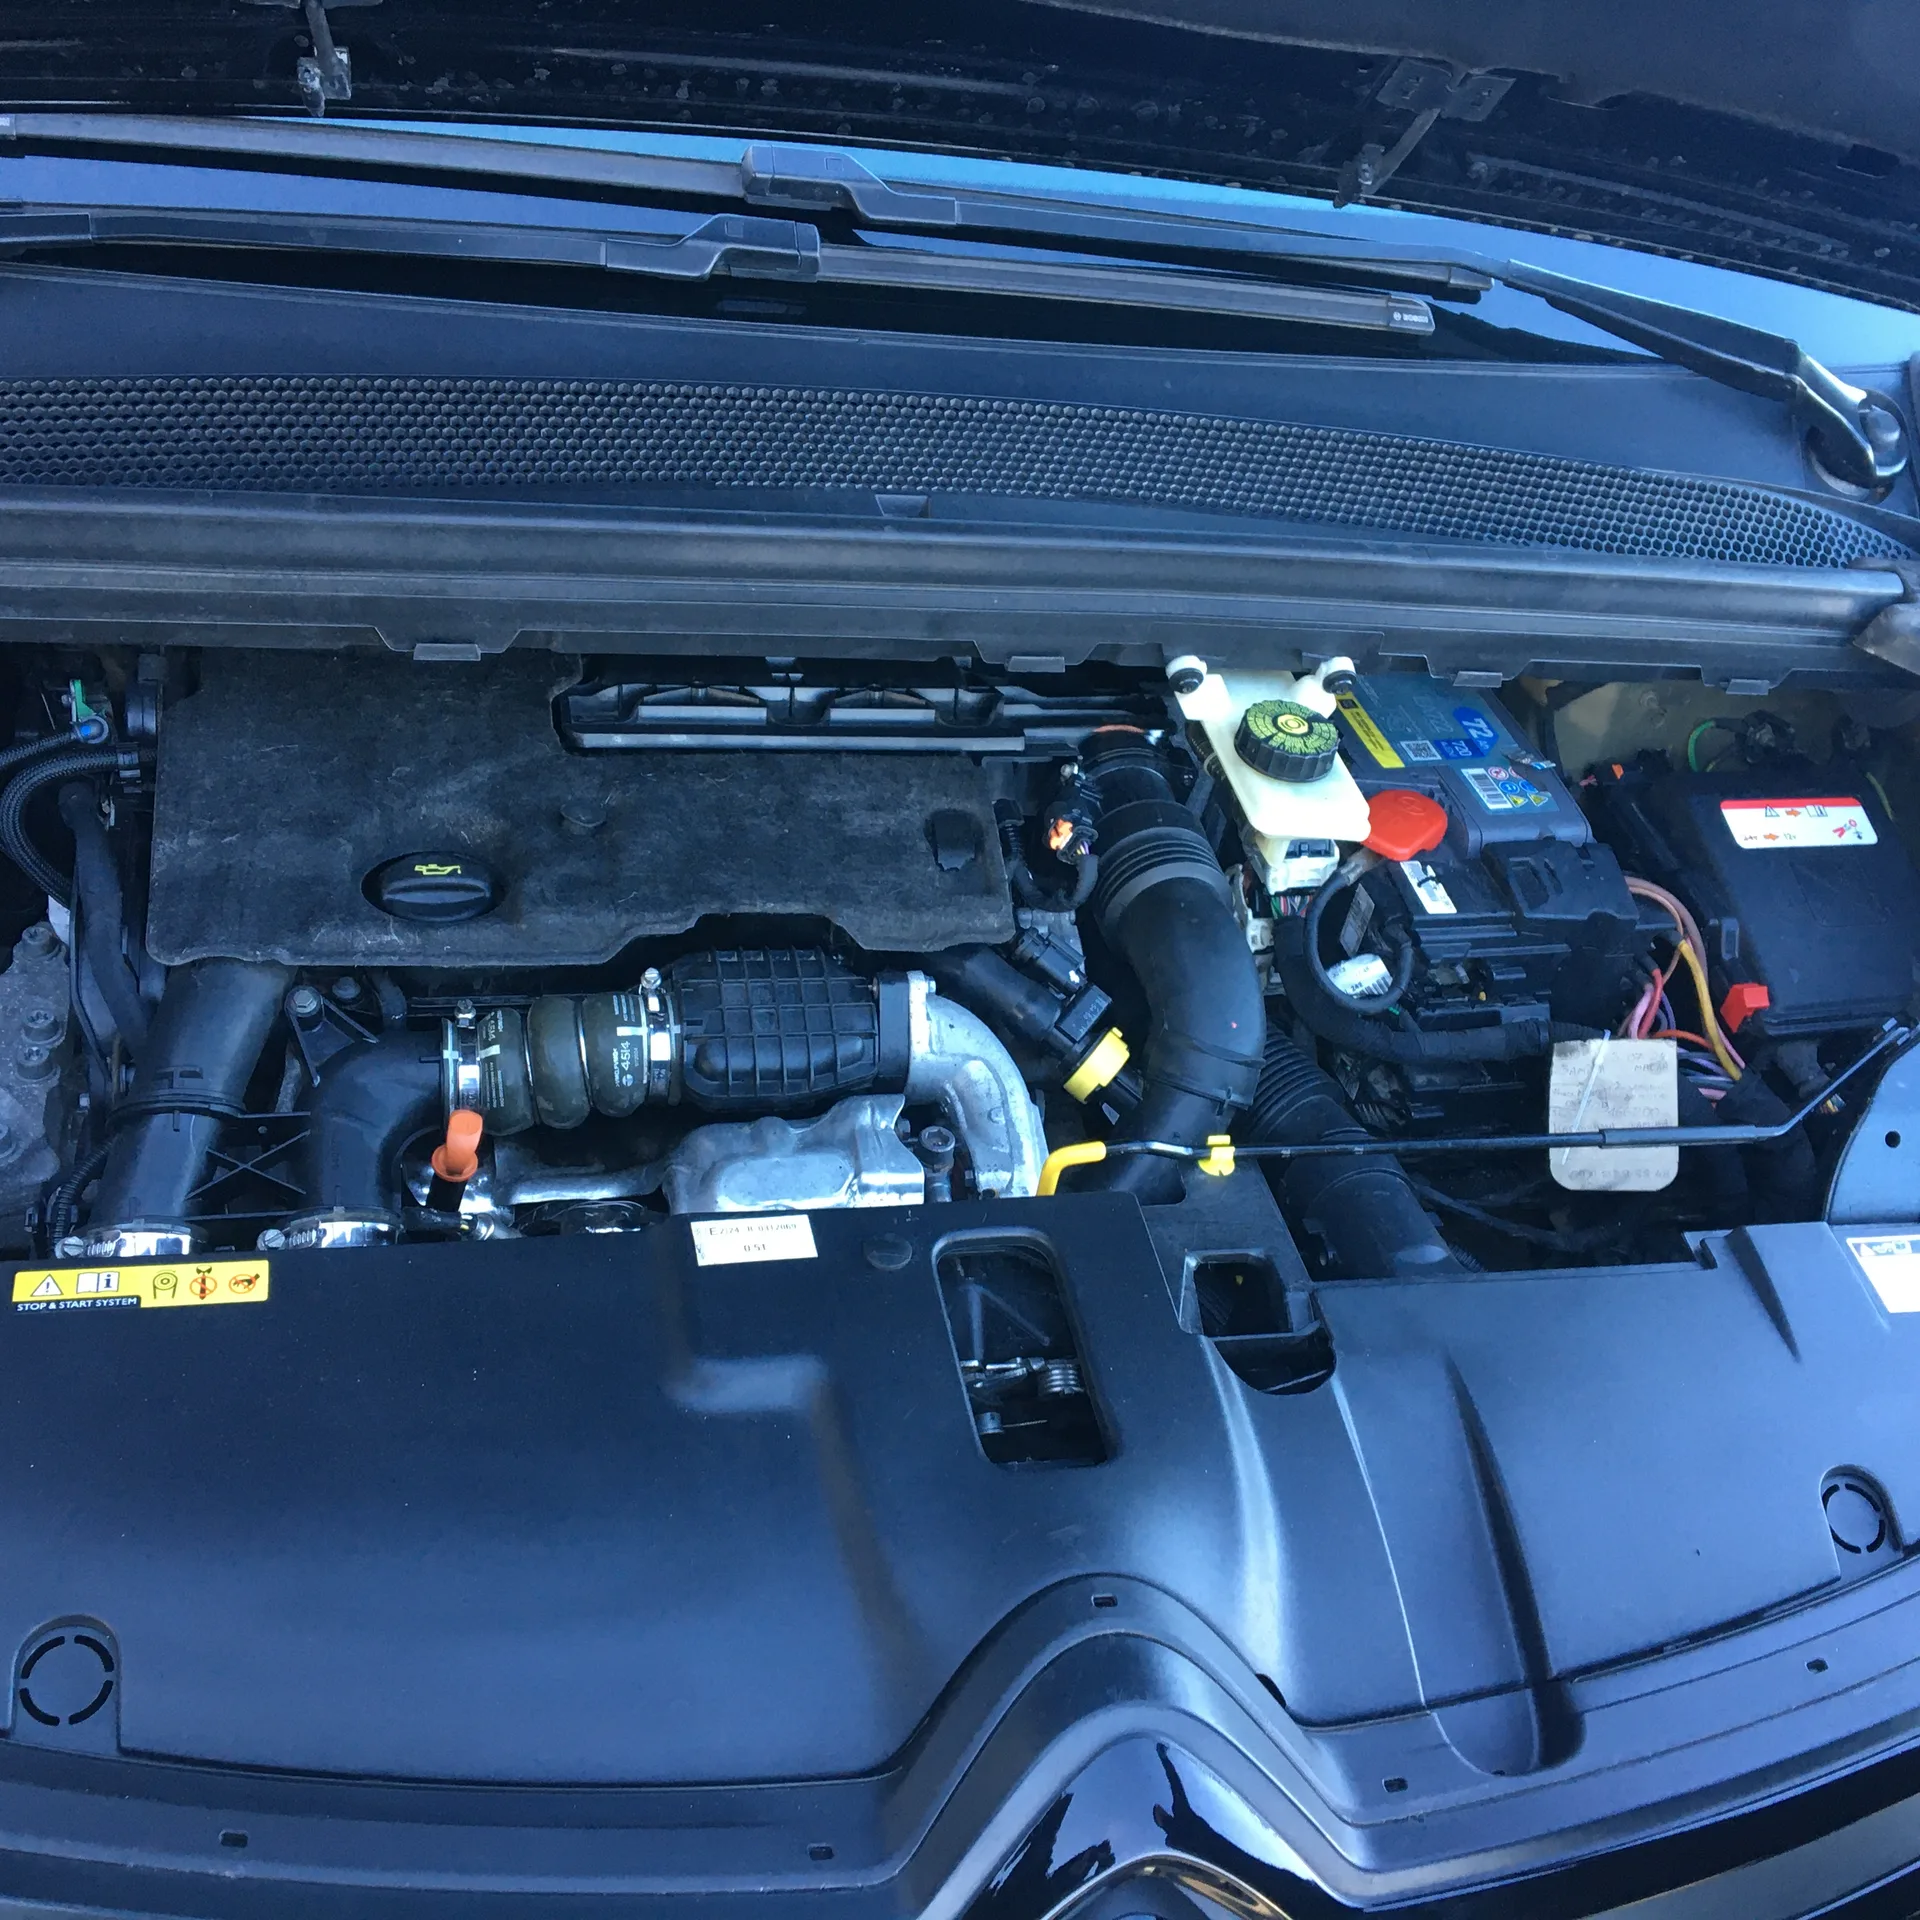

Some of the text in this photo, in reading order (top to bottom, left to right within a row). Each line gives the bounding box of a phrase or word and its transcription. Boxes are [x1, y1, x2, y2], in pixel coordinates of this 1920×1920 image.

[1461, 717, 1494, 739] 72
[1451, 740, 1473, 756] 720
[620, 1040, 631, 1071] 4514
[16, 1297, 138, 1312] STOP & START SYSTEM
